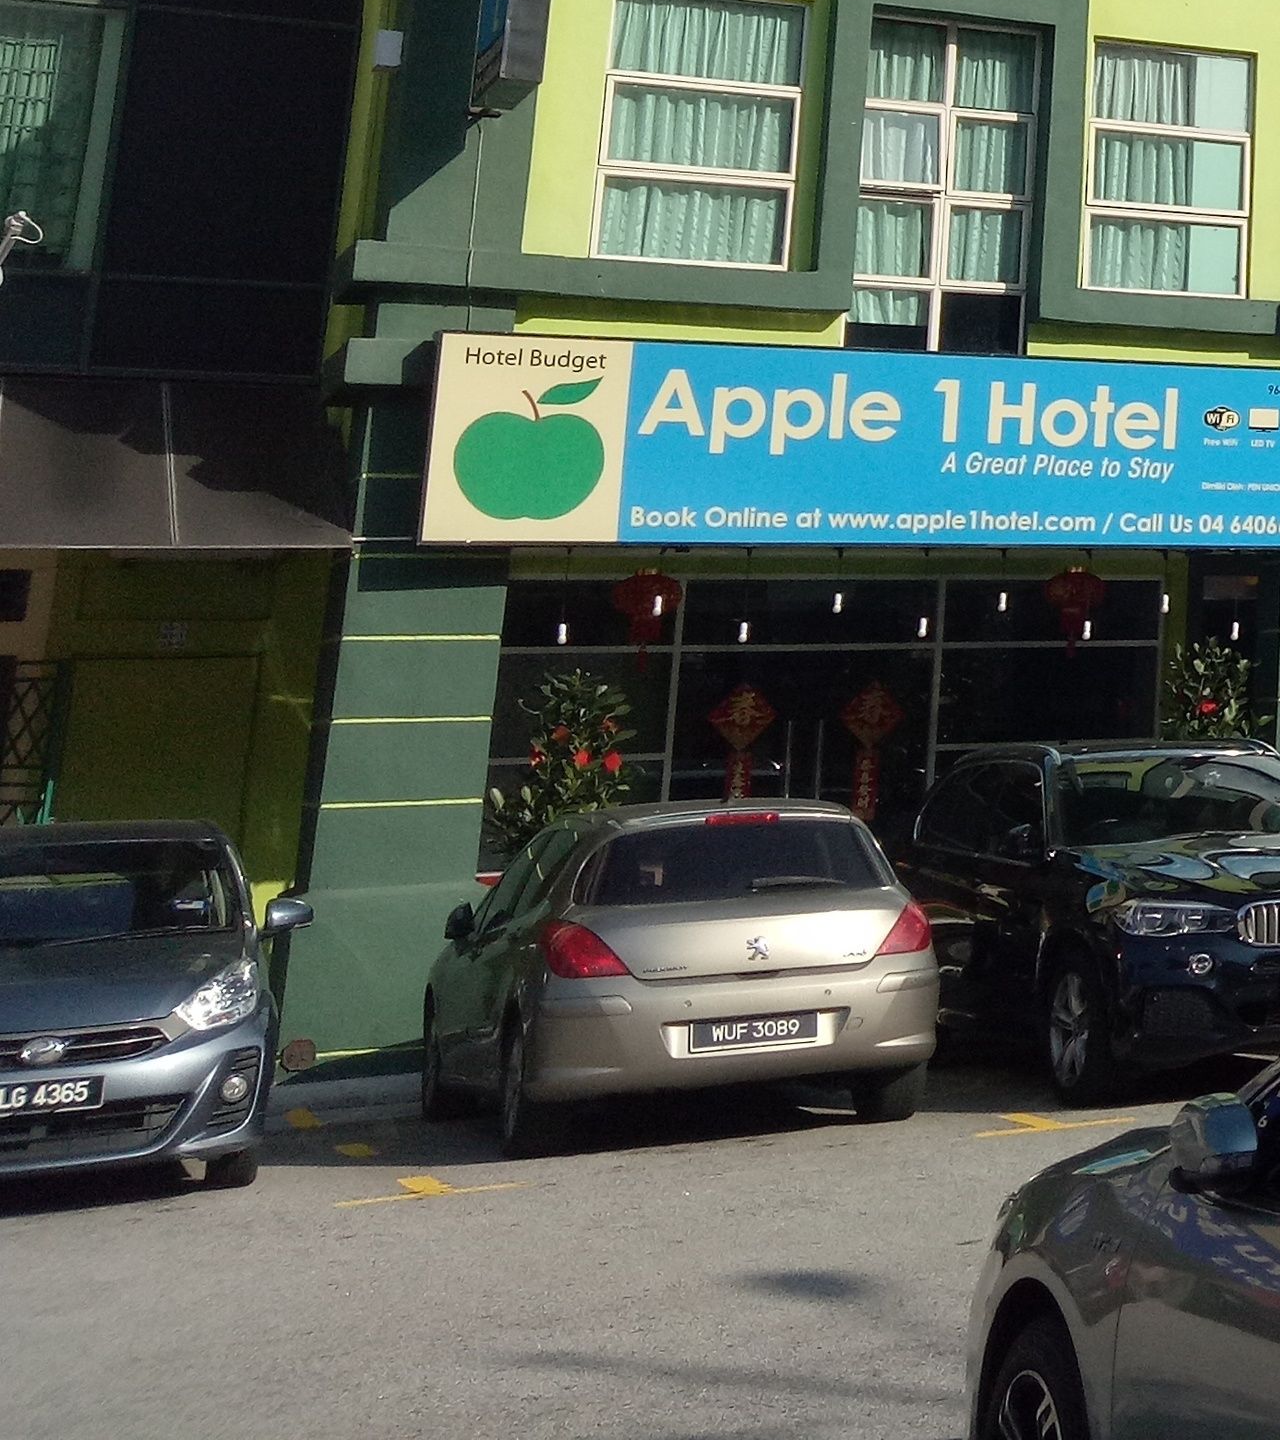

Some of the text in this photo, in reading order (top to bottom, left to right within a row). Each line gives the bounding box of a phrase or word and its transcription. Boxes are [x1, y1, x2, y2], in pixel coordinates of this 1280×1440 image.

[465, 347, 607, 373] Hotel Budget
[637, 368, 1179, 455] Apple 1 Hotel
[941, 452, 1175, 485] A Great Place to Stay
[629, 506, 697, 528] Book
[704, 505, 788, 529] Online
[795, 508, 822, 528] at
[828, 509, 1096, 534] www.apple1hotel.com
[1119, 513, 1163, 534] Call
[1170, 514, 1193, 534] Us
[1198, 515, 1224, 535] 04
[711, 1019, 801, 1043] WUF 3089
[31, 1079, 90, 1105] 4365
